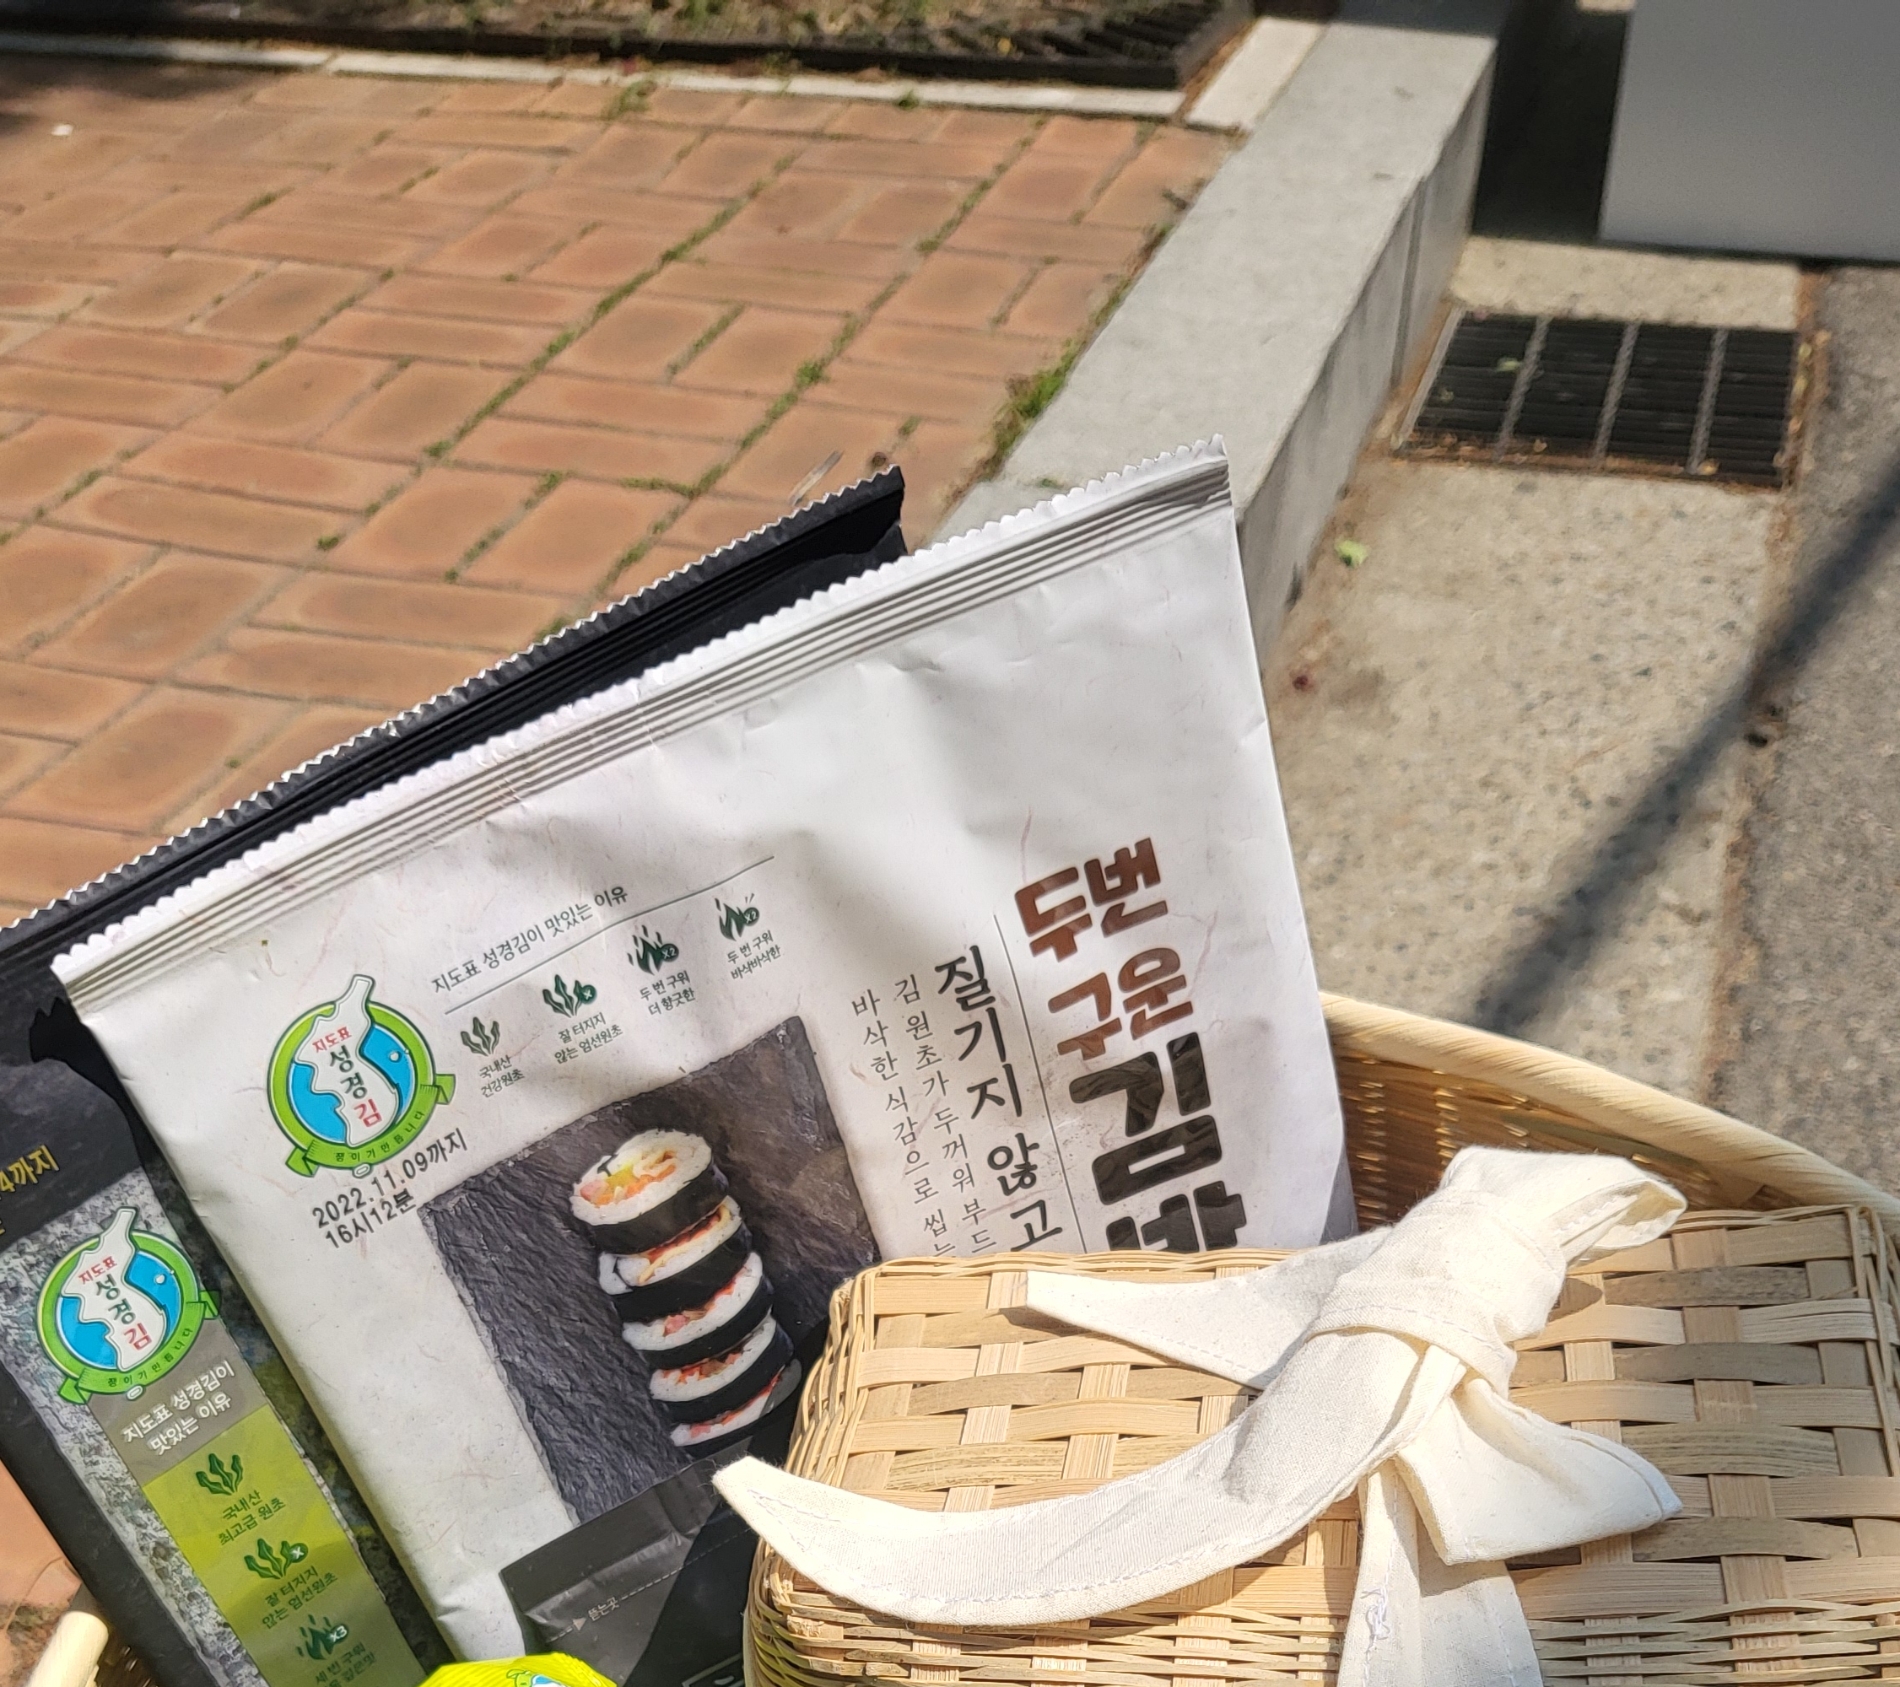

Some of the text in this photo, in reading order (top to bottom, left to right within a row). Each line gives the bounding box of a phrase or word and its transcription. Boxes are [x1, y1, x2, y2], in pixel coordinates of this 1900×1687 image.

[1013, 836, 1169, 963] 두번
[431, 885, 628, 994] 지도표 성경김이 맛있는 이유
[752, 929, 774, 951] 구워
[666, 969, 691, 990] 구워
[571, 1012, 607, 1036] 터지지
[1047, 946, 1194, 1061] 구운
[312, 1026, 352, 1053] 지도표
[554, 1043, 580, 1064] 않는
[479, 1056, 513, 1079] 국내산
[851, 989, 900, 1082] 바삭한
[884, 1085, 940, 1205] 식감으로
[934, 944, 1063, 1253] 질기지 않고
[311, 1127, 468, 1229] 2022.11.09까지
[325, 1187, 417, 1249] 16시12분
[77, 1256, 118, 1285] 지도표
[122, 1359, 235, 1444] 지도표 성경김이
[149, 1392, 232, 1456] 맛있는 이유
[218, 1496, 287, 1546] 최고급 원초
[222, 1489, 262, 1521] 국내산
[265, 1565, 319, 1606] 잘 터지지
[262, 1607, 290, 1630] 않는
